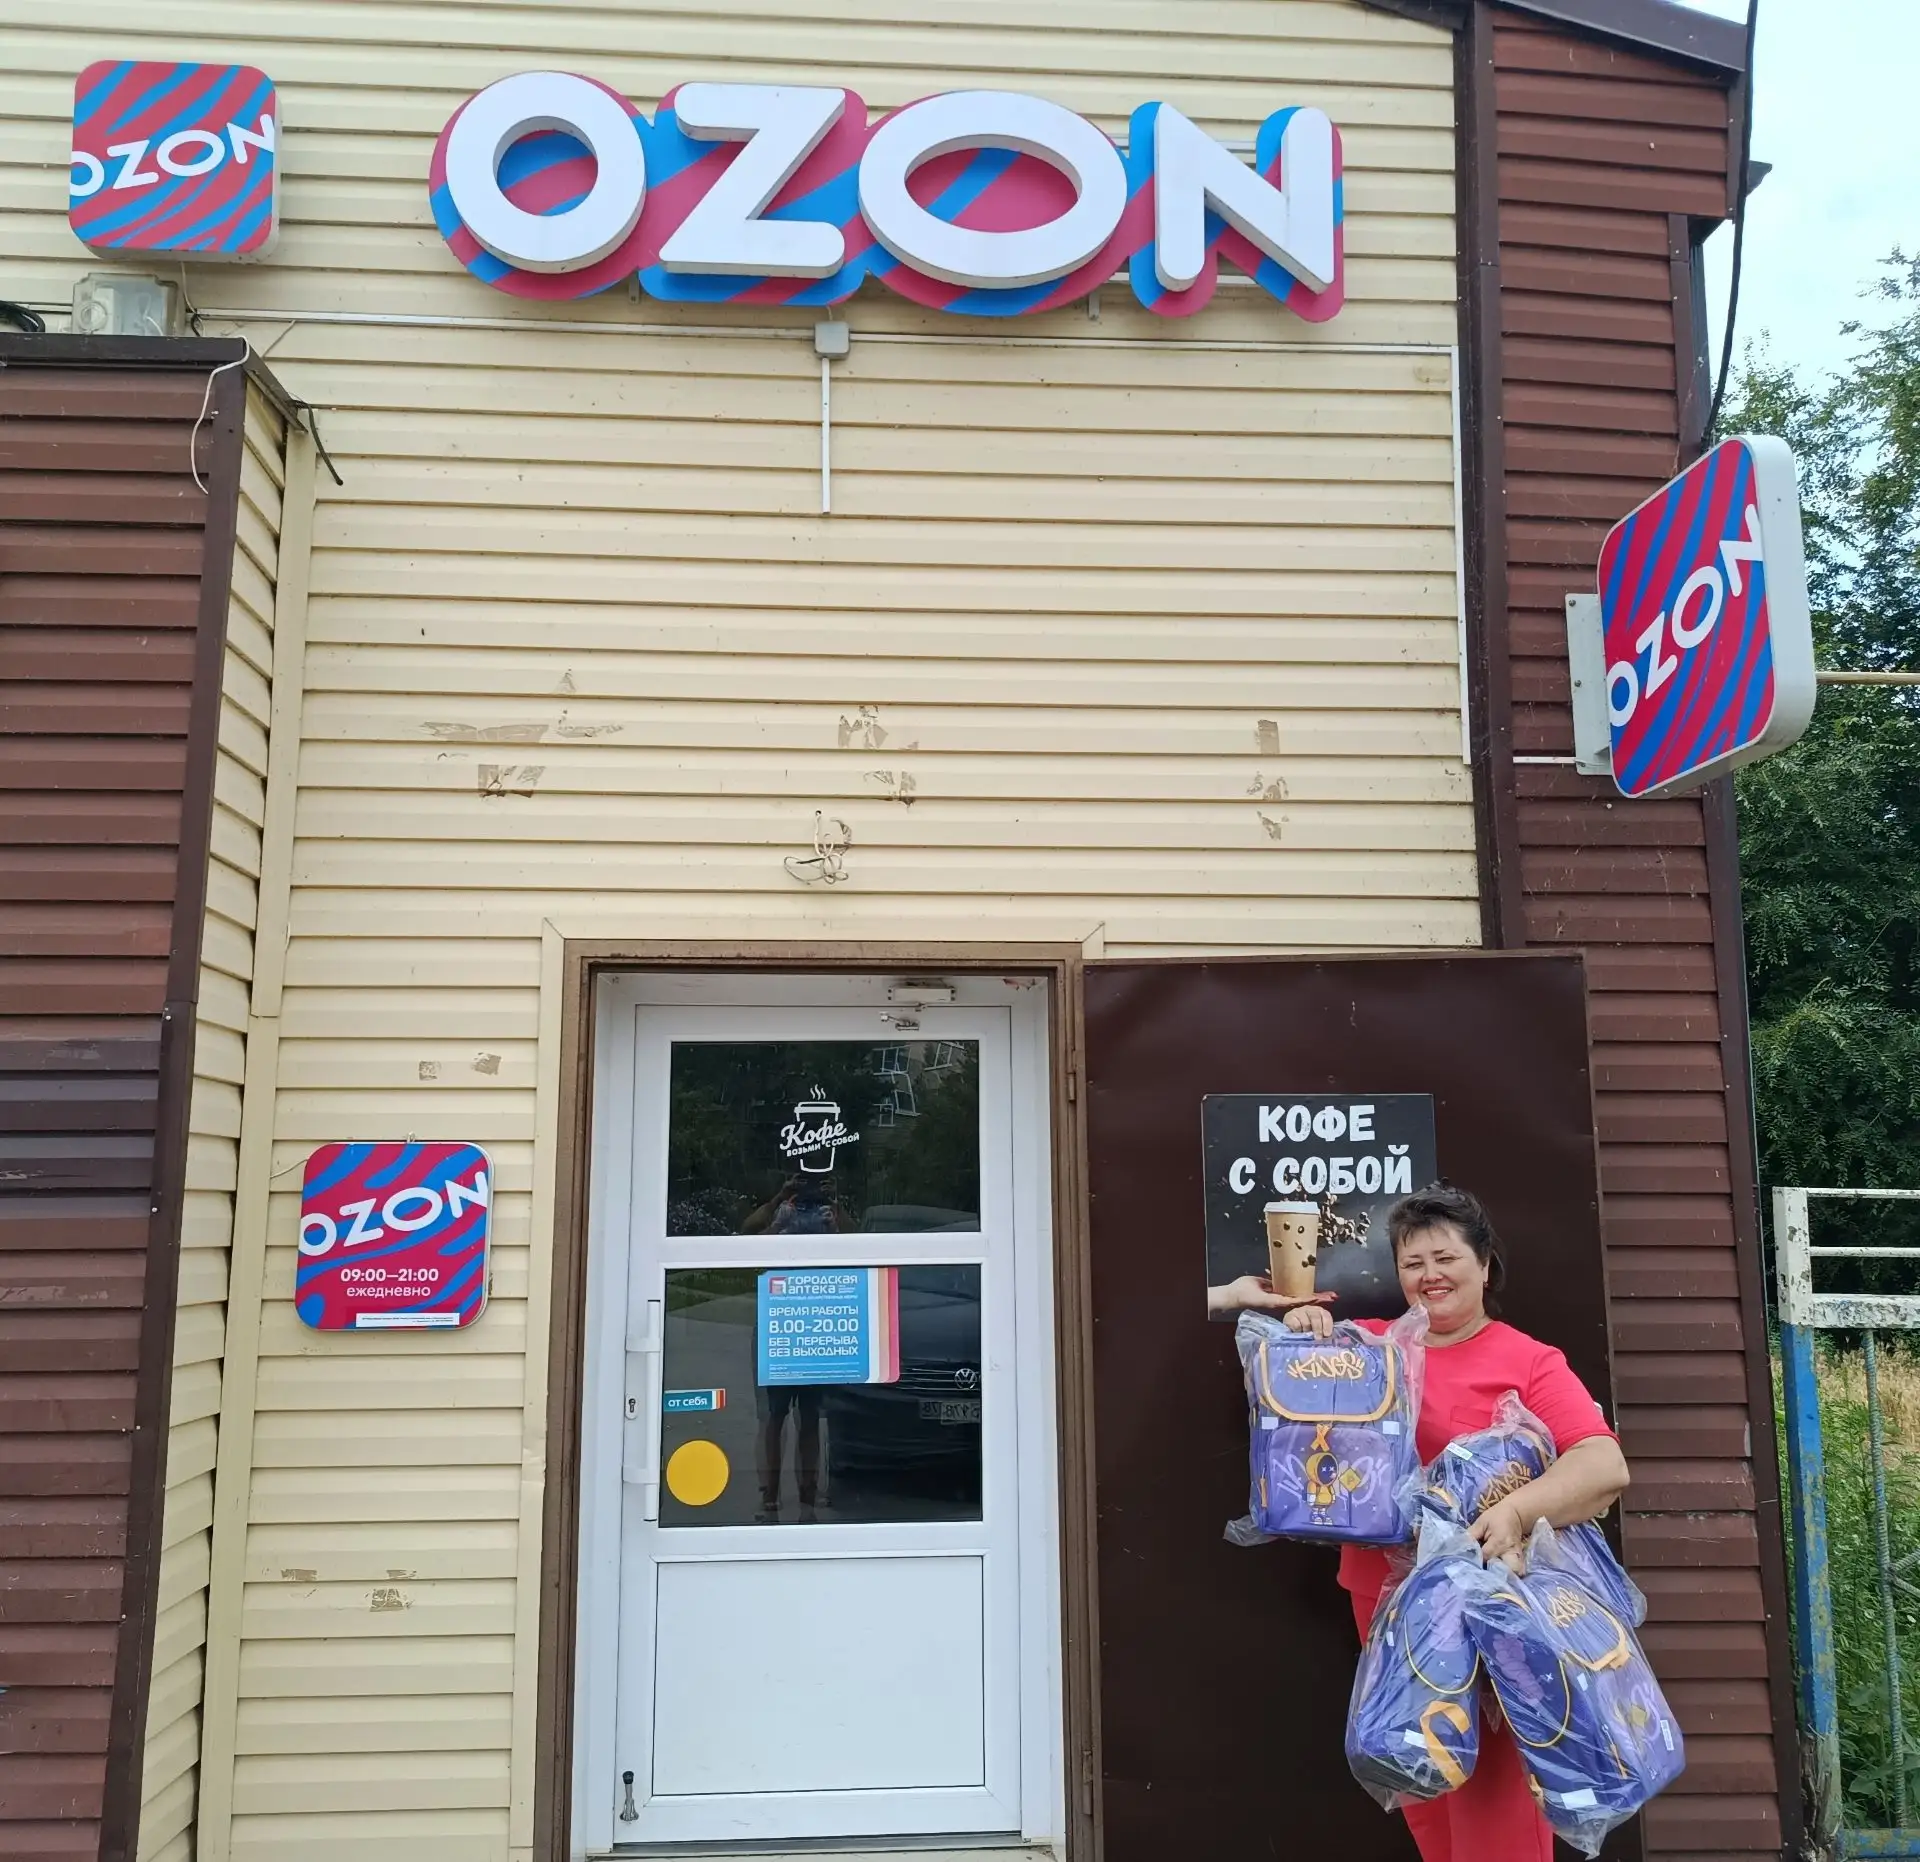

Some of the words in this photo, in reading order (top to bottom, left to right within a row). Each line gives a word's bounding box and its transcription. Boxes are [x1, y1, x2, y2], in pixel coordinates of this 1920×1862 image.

[69, 114, 275, 197] OZON
[446, 71, 1334, 292] OZON
[1607, 504, 1763, 727] OZON
[780, 1119, 847, 1150] Кофе
[1258, 1104, 1375, 1142] КОФЕ
[786, 1143, 821, 1157] ВОЗЬМИ
[832, 1132, 860, 1146] СОБОЙ
[1229, 1157, 1256, 1194] С
[1272, 1144, 1412, 1194] СОБОЙ
[299, 1171, 488, 1256] OZON
[346, 1286, 431, 1298] ежедневно
[788, 1284, 836, 1294] аптека
[769, 1306, 809, 1316] ВРЕМЯ
[812, 1305, 859, 1316] РАБОТЫ
[769, 1337, 791, 1347] БЕЗ
[797, 1335, 859, 1346] ПЕРЕРЫВА
[769, 1347, 791, 1357] БЕЗ
[793, 1346, 859, 1357] ВЫХОДНЫХ
[668, 1399, 681, 1407] от
[682, 1396, 708, 1406] себя
